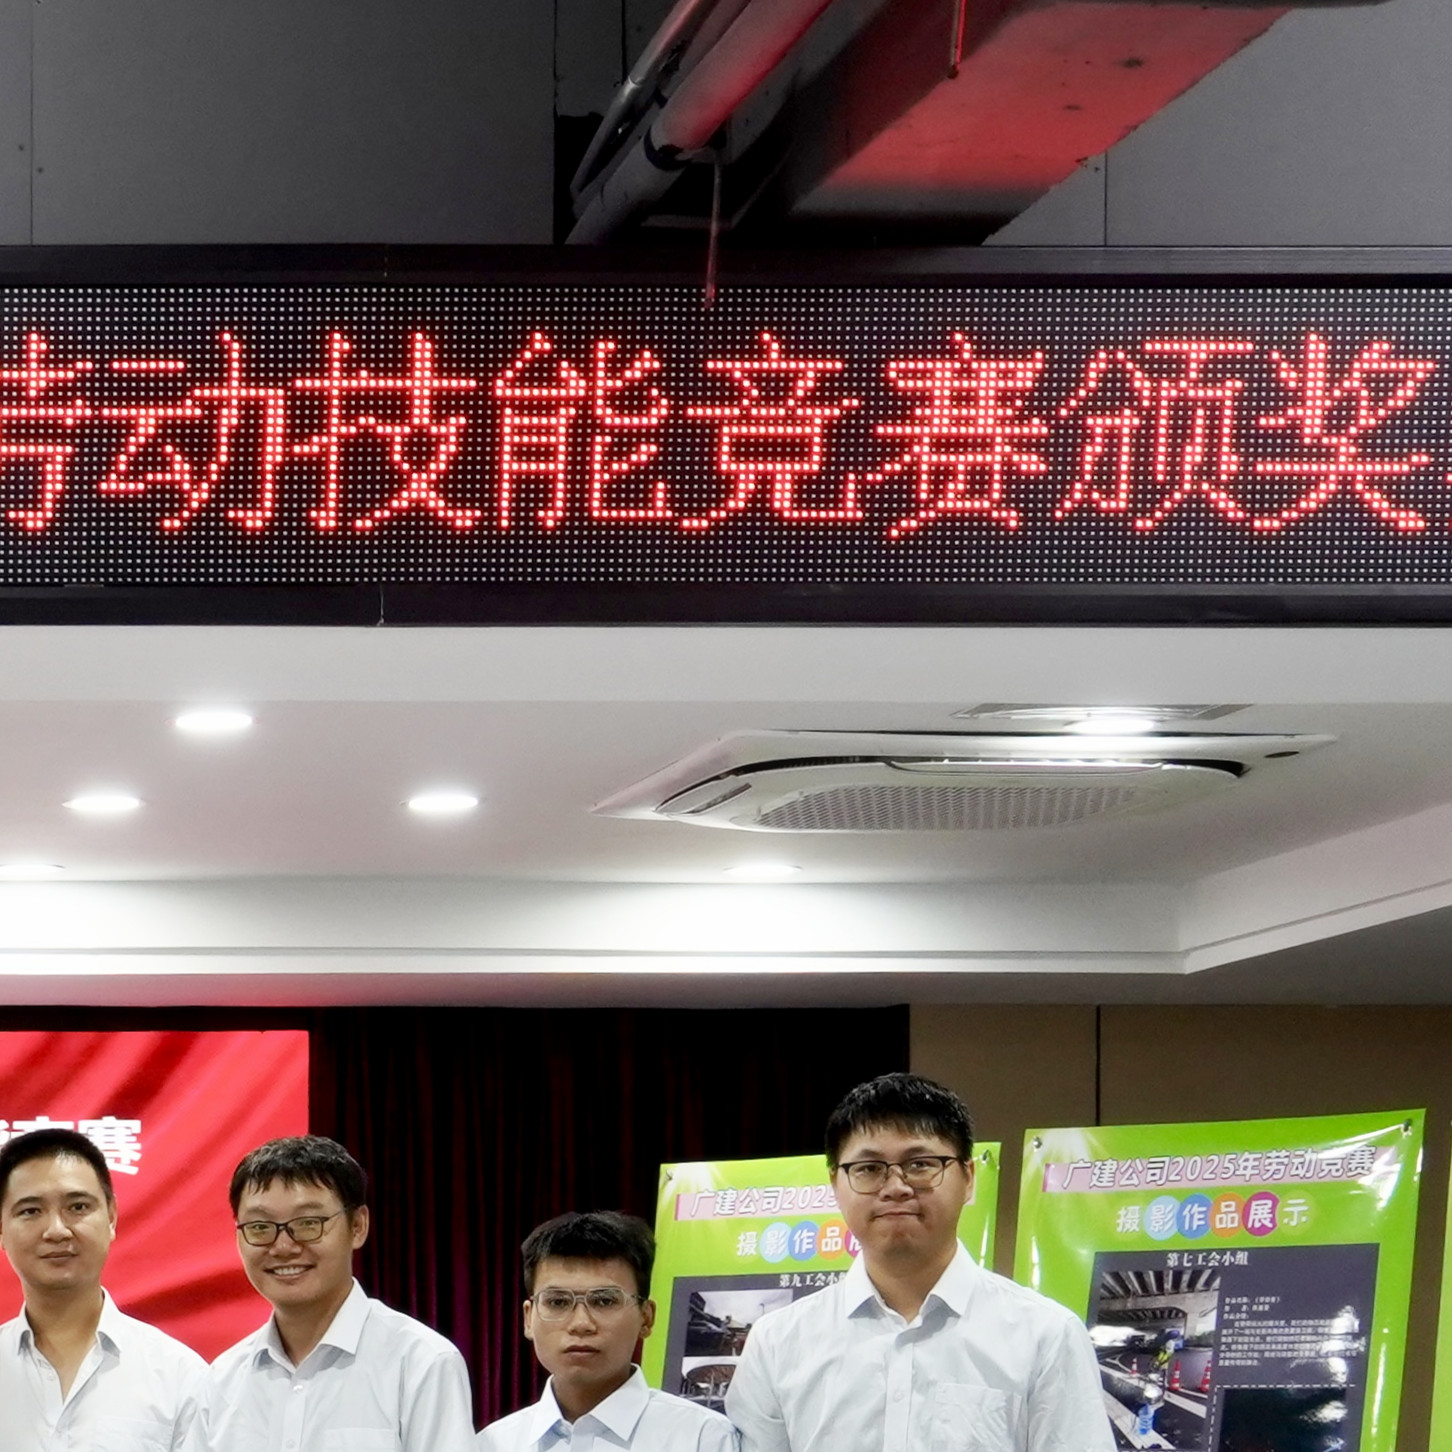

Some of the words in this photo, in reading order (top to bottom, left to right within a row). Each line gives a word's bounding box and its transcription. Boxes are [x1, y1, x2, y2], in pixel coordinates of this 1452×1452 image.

[1116, 1197, 1310, 1233] 摄影作品展示
[1166, 1251, 1249, 1267] 第七工会小组
